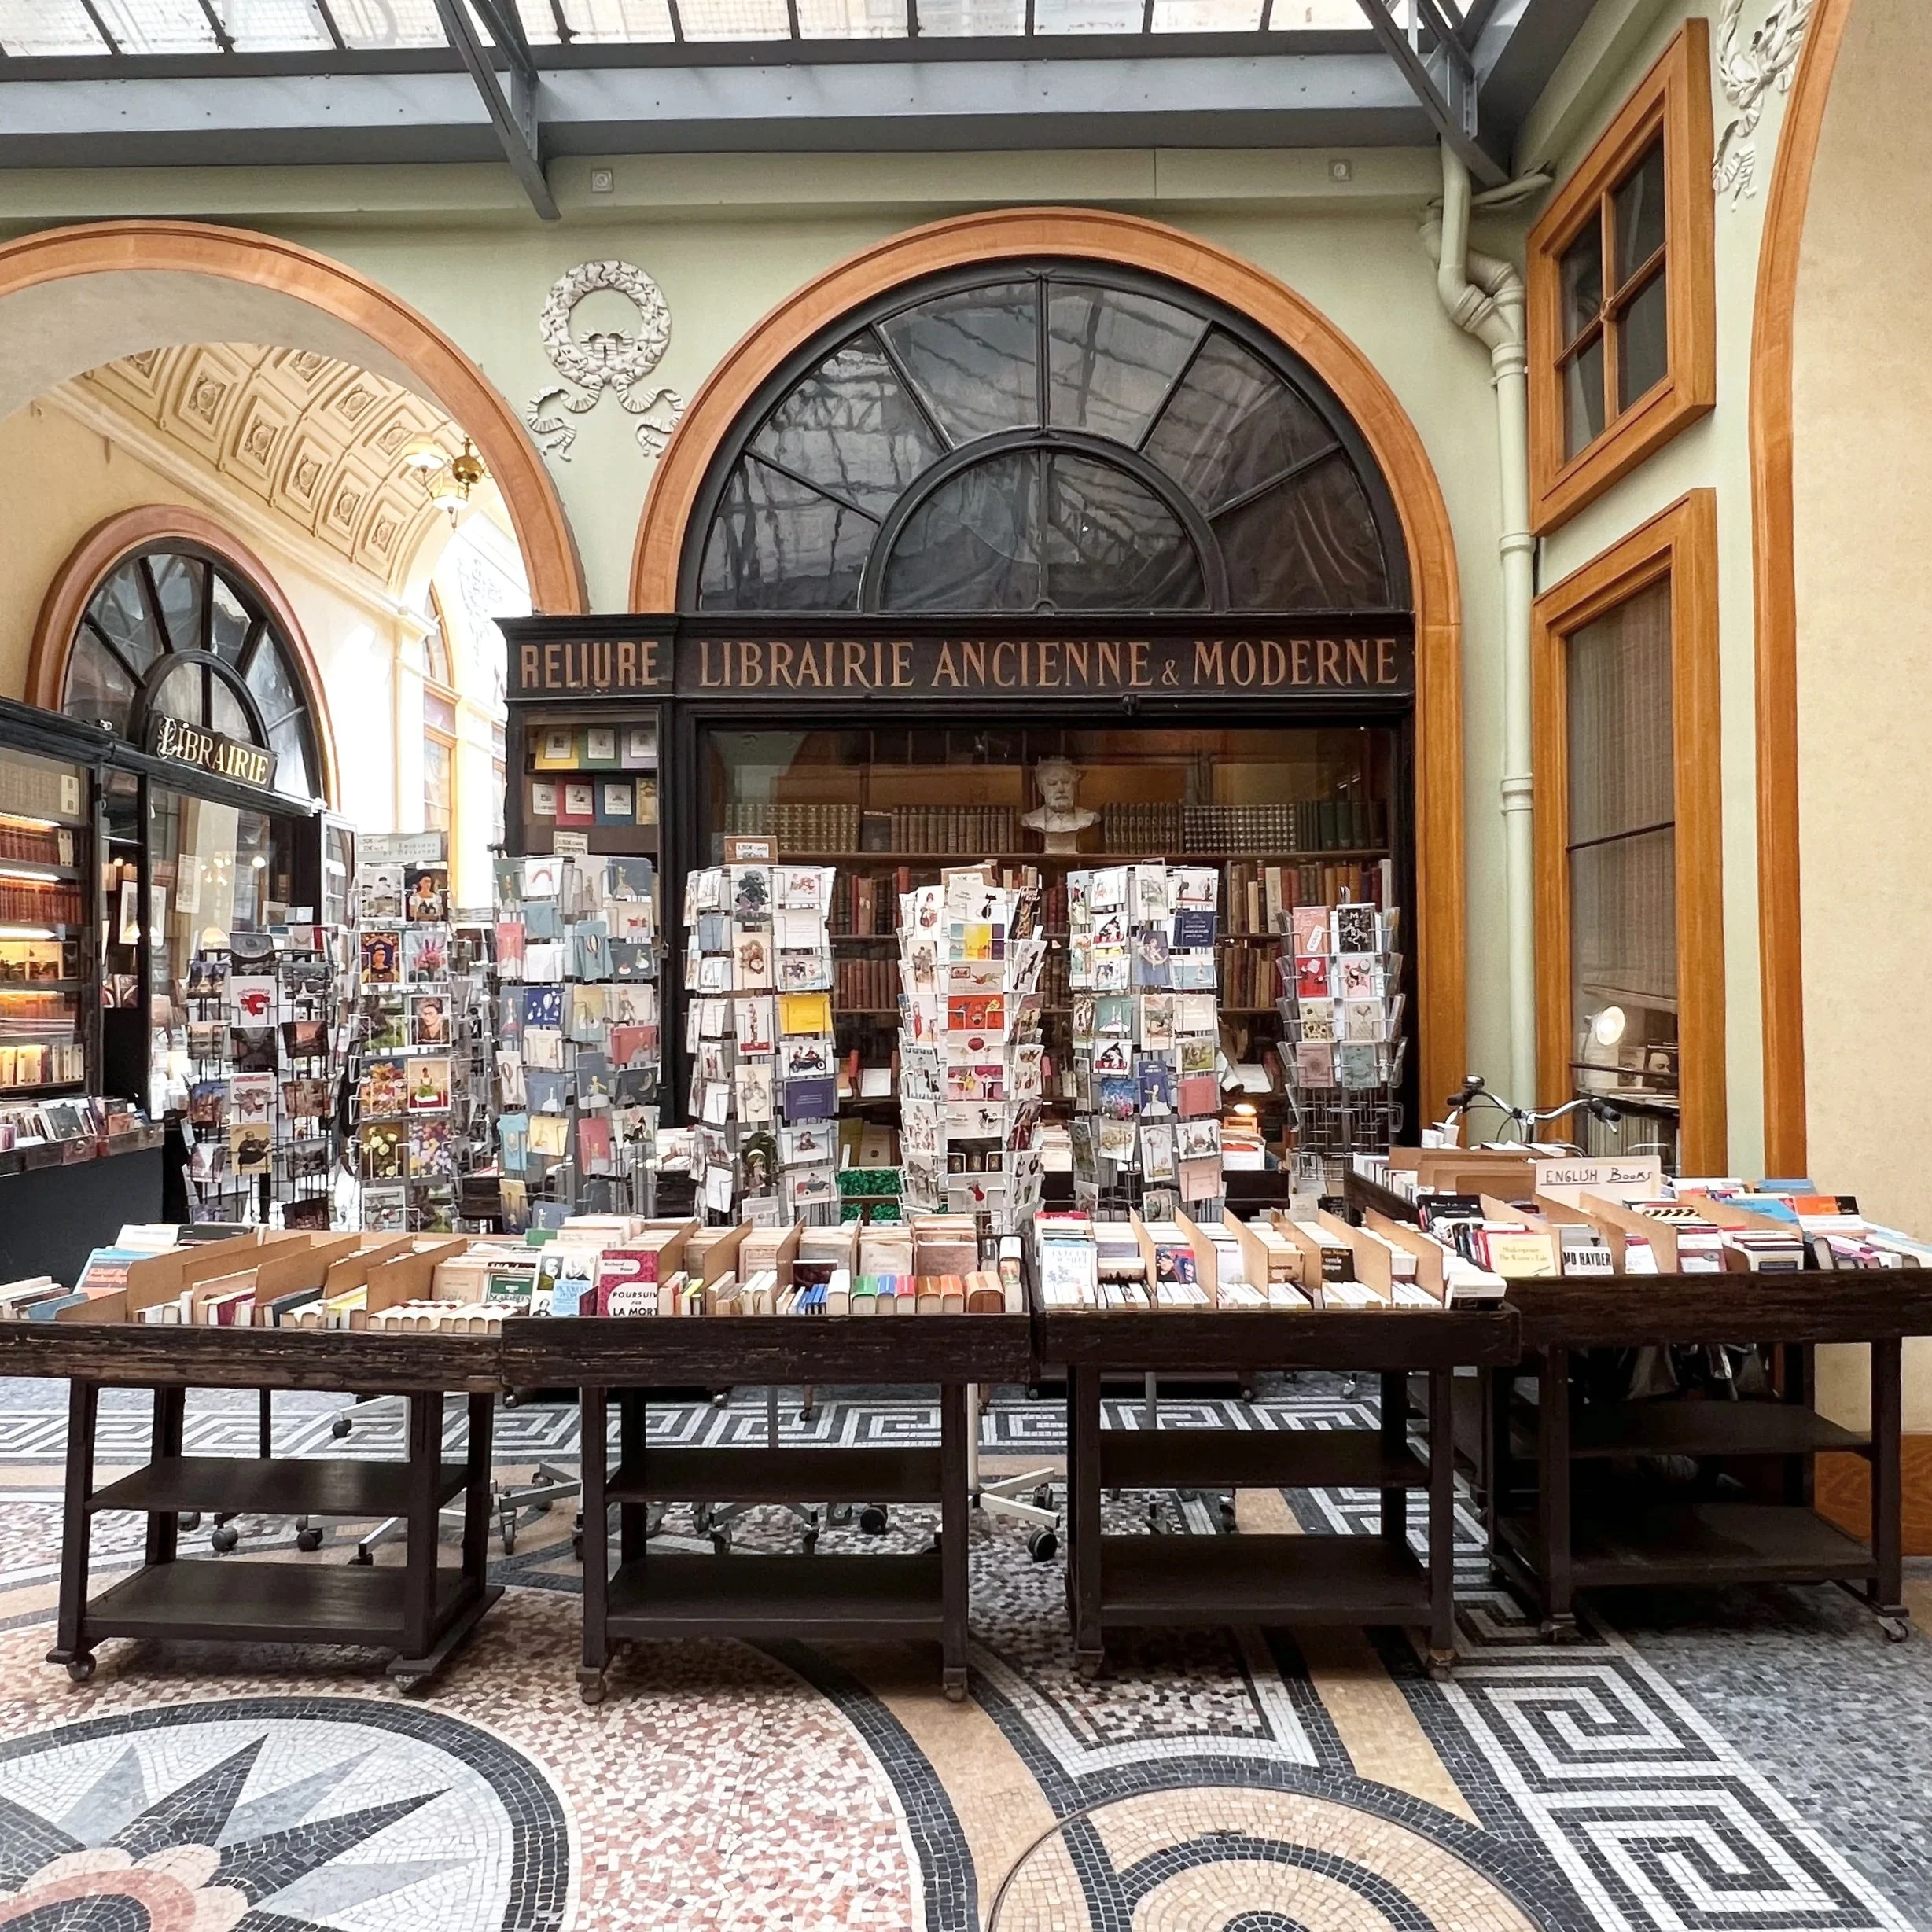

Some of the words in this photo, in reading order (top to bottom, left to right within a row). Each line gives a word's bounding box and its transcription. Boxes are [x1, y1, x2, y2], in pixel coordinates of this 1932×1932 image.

[520, 641, 660, 690] RELIURE
[698, 641, 914, 690] LIBRAIRIE
[930, 640, 1154, 687] ANCIENNE
[1161, 658, 1179, 686] &
[1192, 638, 1399, 688] MODERNE
[1546, 1167, 1598, 1183] ENGLISH
[1578, 1252, 1612, 1267] HAYDER
[613, 1308, 625, 1316] LA
